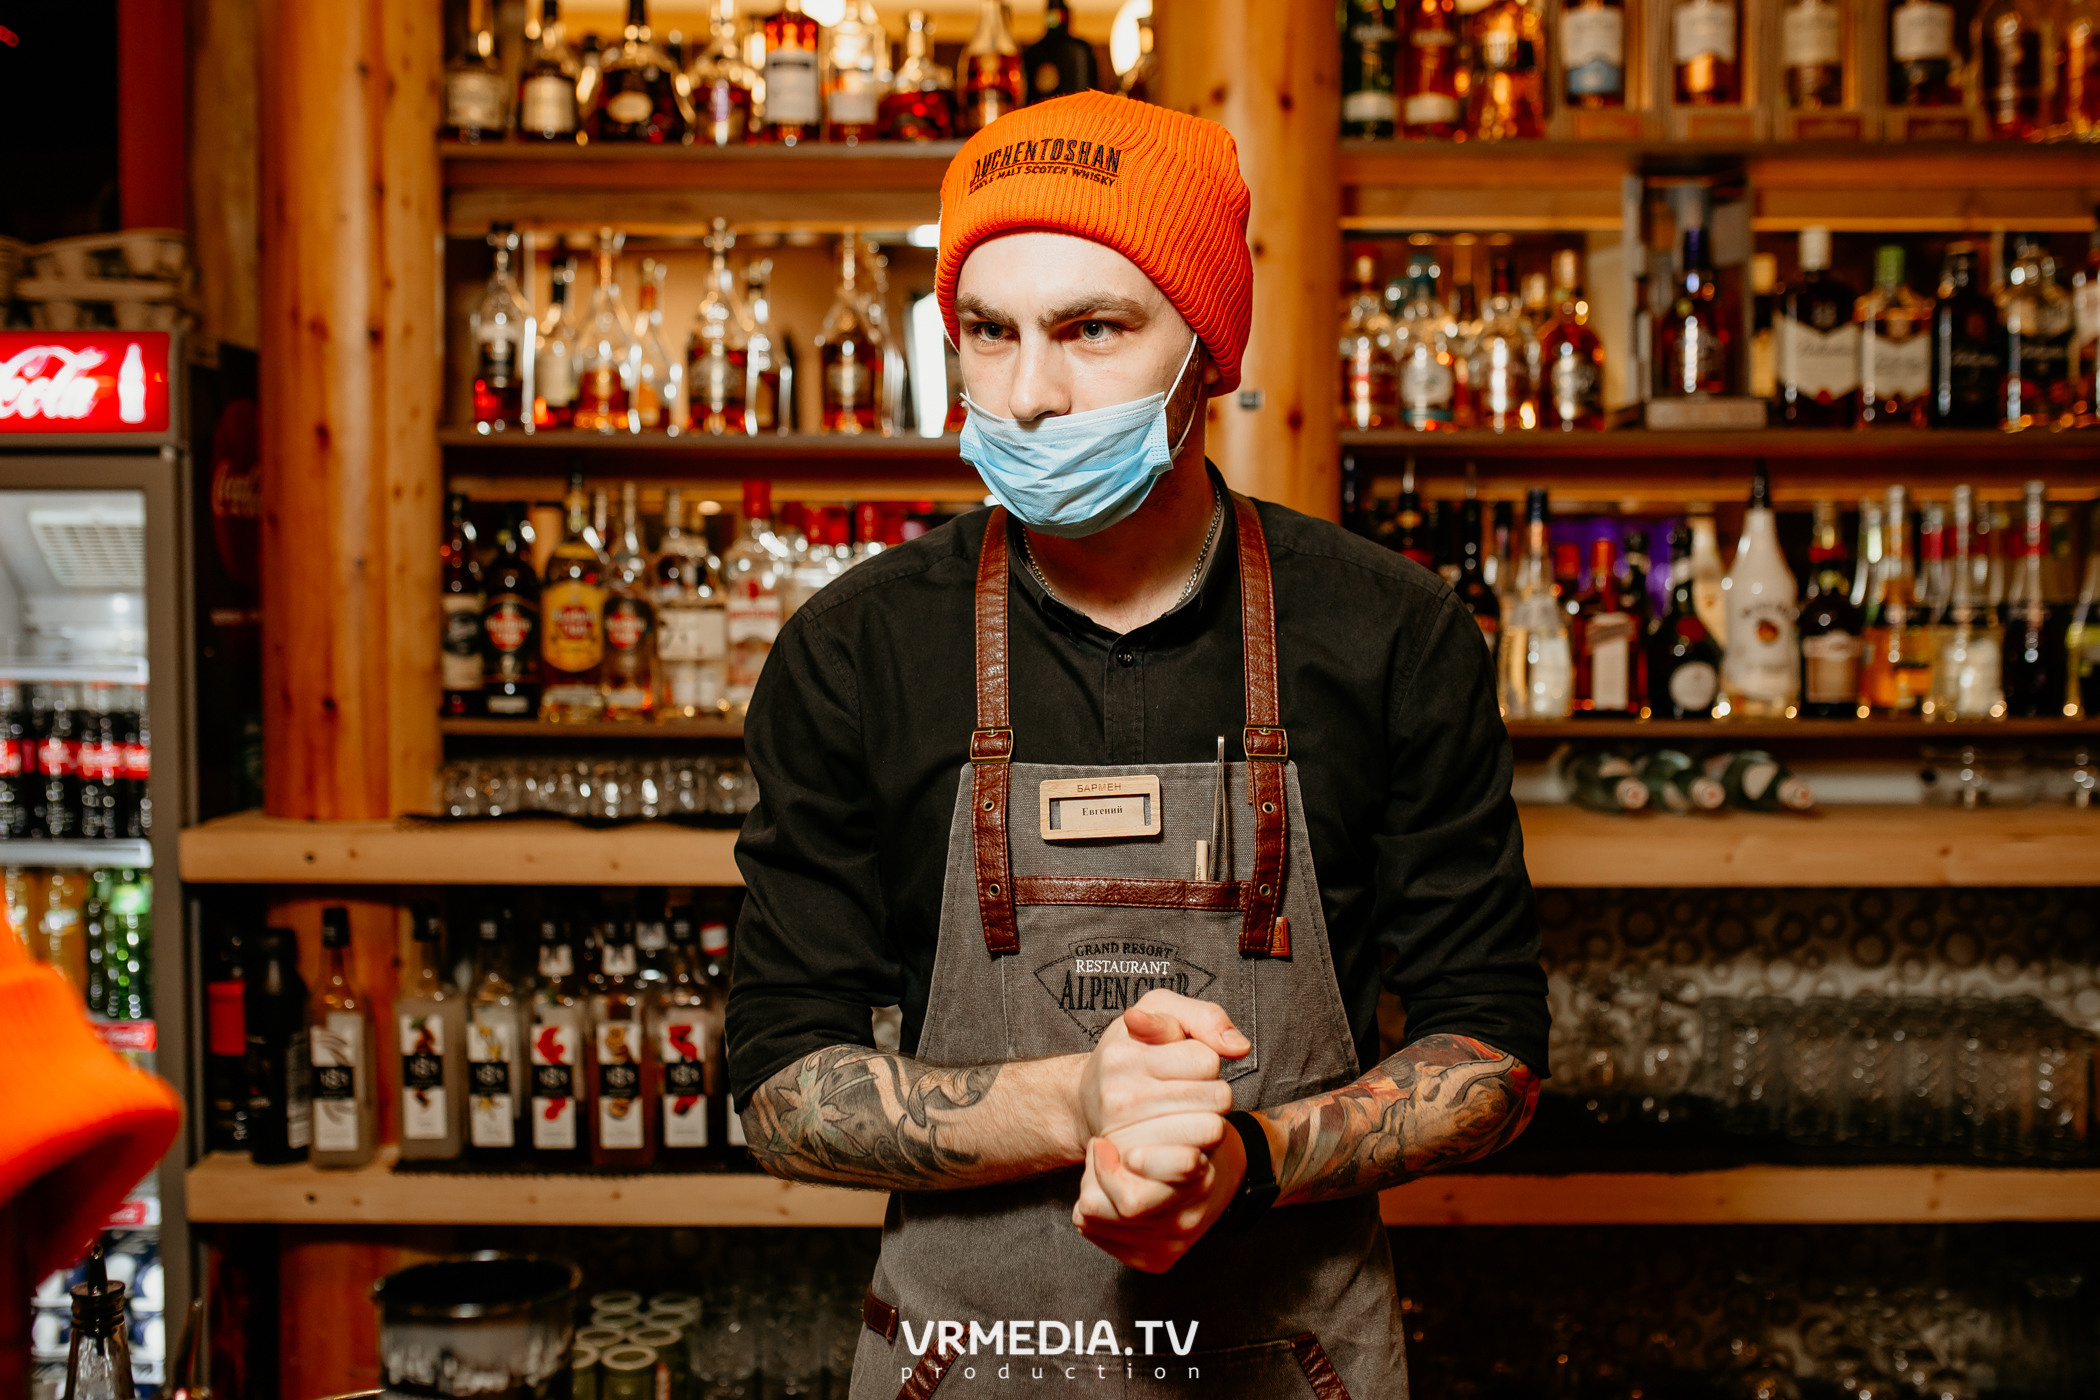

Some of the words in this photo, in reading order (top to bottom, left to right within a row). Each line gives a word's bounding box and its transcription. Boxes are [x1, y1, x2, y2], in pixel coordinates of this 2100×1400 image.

[971, 138, 1122, 184] AUCHENTOSHAN
[997, 167, 1022, 179] MALT
[1024, 165, 1067, 175] SCOTCH
[1072, 167, 1116, 187] WHISKY
[1076, 783, 1122, 793] БАРМЕН
[1082, 805, 1123, 816] Евгений
[1075, 942, 1119, 957] GRAND
[1122, 942, 1174, 959] RESORT
[1075, 959, 1171, 975] RESTAURANT
[1059, 970, 1130, 1011] ALPEN
